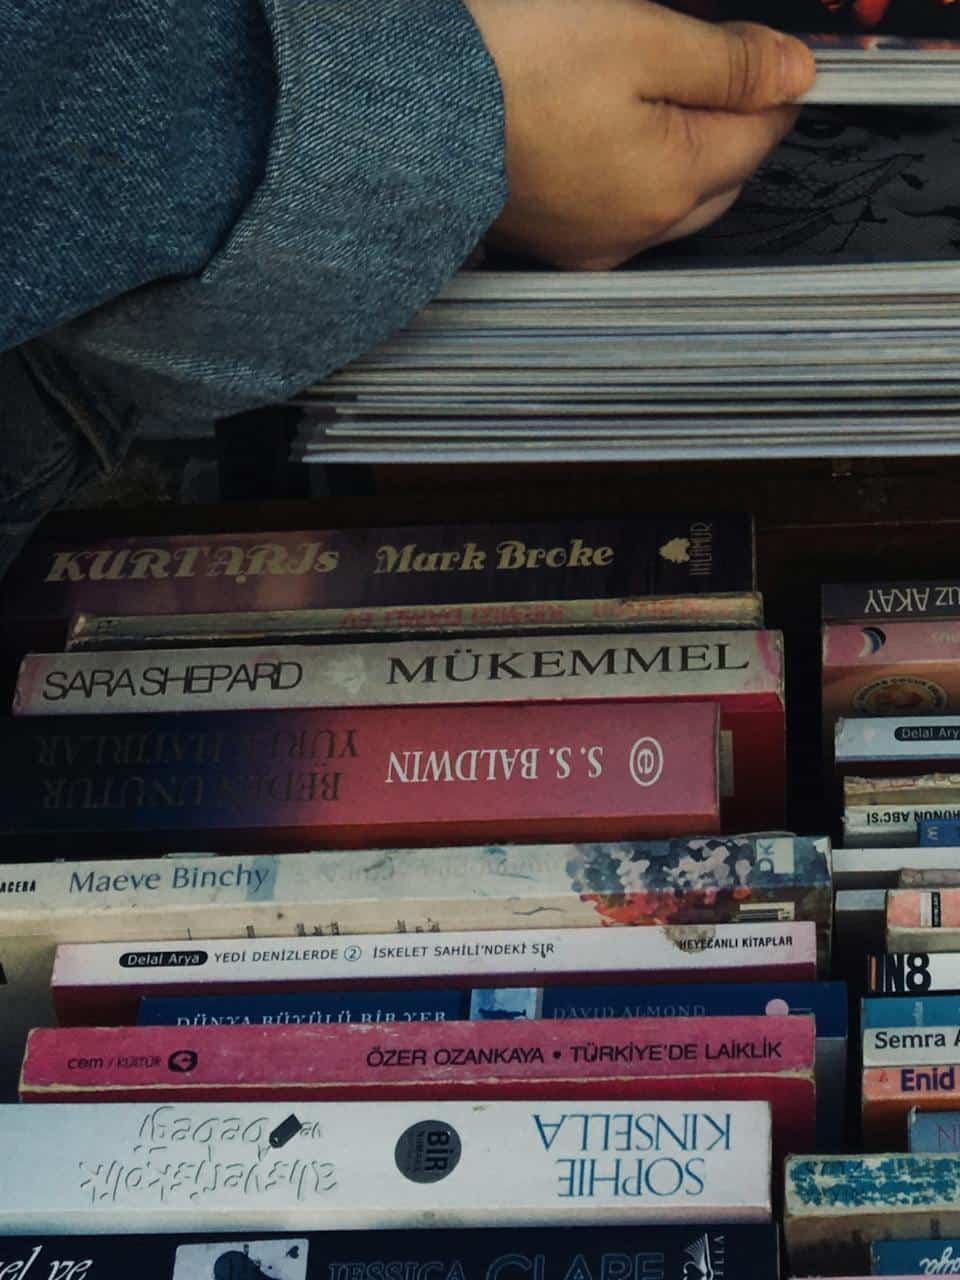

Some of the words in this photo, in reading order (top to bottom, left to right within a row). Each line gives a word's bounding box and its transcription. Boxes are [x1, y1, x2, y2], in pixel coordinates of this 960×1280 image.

[373, 543, 488, 575] Mark
[496, 538, 616, 570] Broke
[863, 587, 930, 614] AKAY
[386, 641, 750, 685] MÜKEMMEL
[42, 668, 138, 701] SARA
[139, 660, 304, 697] SHEPARD
[384, 747, 540, 784] BALDWIN
[69, 869, 162, 894] Maeve
[172, 863, 272, 892] Binchy
[214, 949, 247, 963] YEDİ
[252, 947, 339, 963] DENİZLERDE
[373, 942, 428, 959] İSKELET
[741, 933, 793, 949] KİTAPLAR
[126, 951, 164, 967] Delal
[167, 950, 201, 967] Arya
[623, 1003, 706, 1019] ALMOND
[366, 1046, 427, 1068] ÖZER
[434, 1048, 545, 1066] OZANKAYA
[570, 1041, 698, 1063] TÜRKİYE'DE
[705, 1036, 782, 1060] LAİKLİK
[874, 1030, 946, 1050] Semra
[67, 1056, 104, 1070] cem
[900, 1067, 955, 1091] Enid
[533, 1113, 732, 1152] KINSELLA
[424, 1130, 454, 1172] BİR
[557, 1157, 706, 1198] SOPHIE
